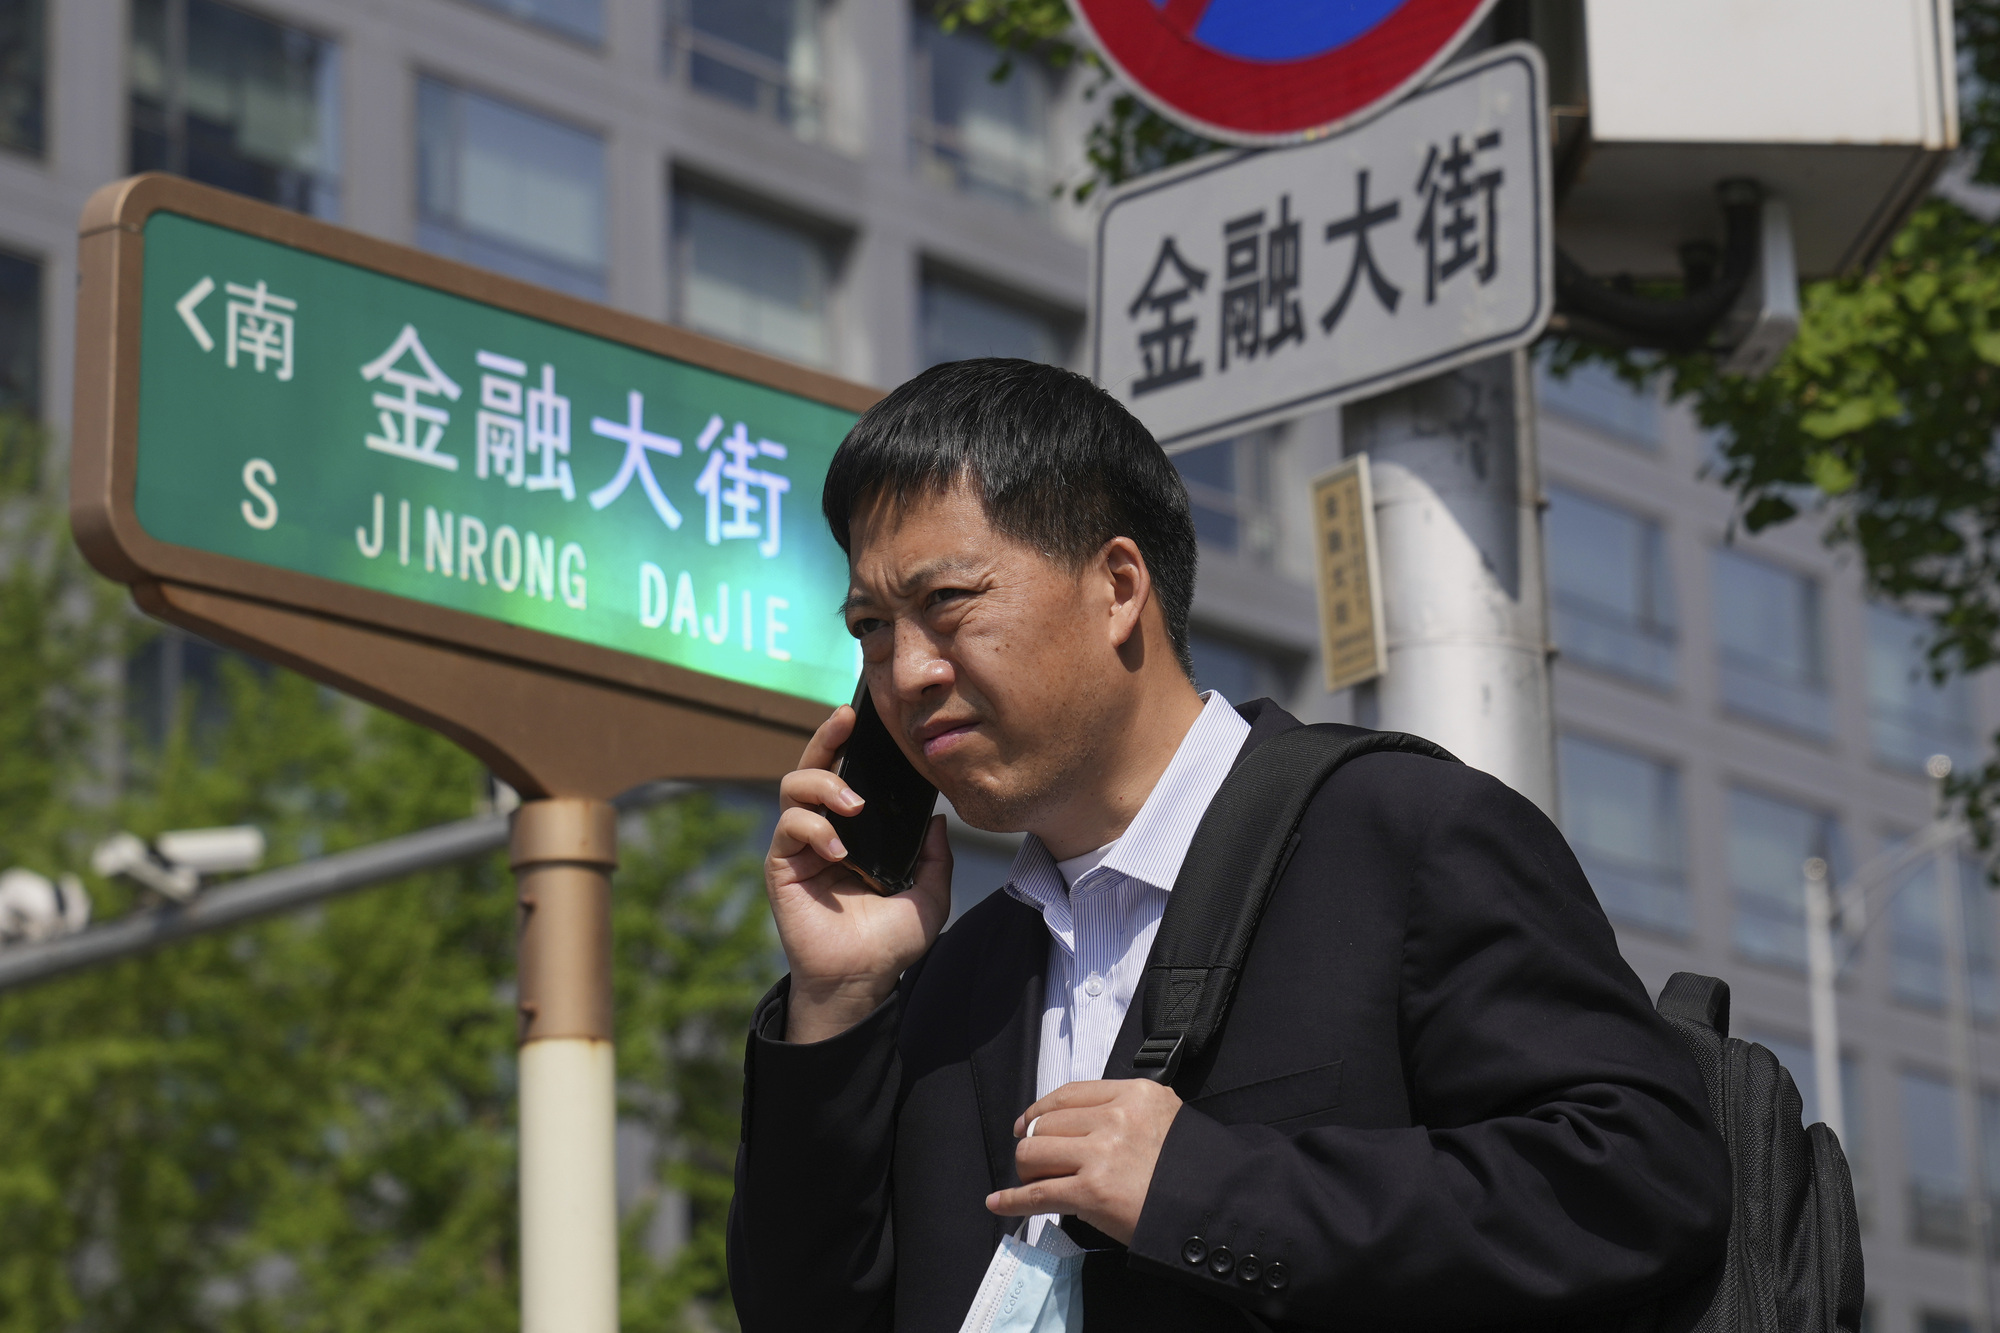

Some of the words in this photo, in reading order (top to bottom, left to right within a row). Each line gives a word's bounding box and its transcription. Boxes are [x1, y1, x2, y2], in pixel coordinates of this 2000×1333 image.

[225, 281, 297, 381] 南
[1128, 131, 1504, 398] 金融大街
[241, 459, 279, 530] S
[361, 325, 791, 558] 金融大街
[357, 493, 588, 610] JINRONG
[640, 562, 792, 661] DAJIE
